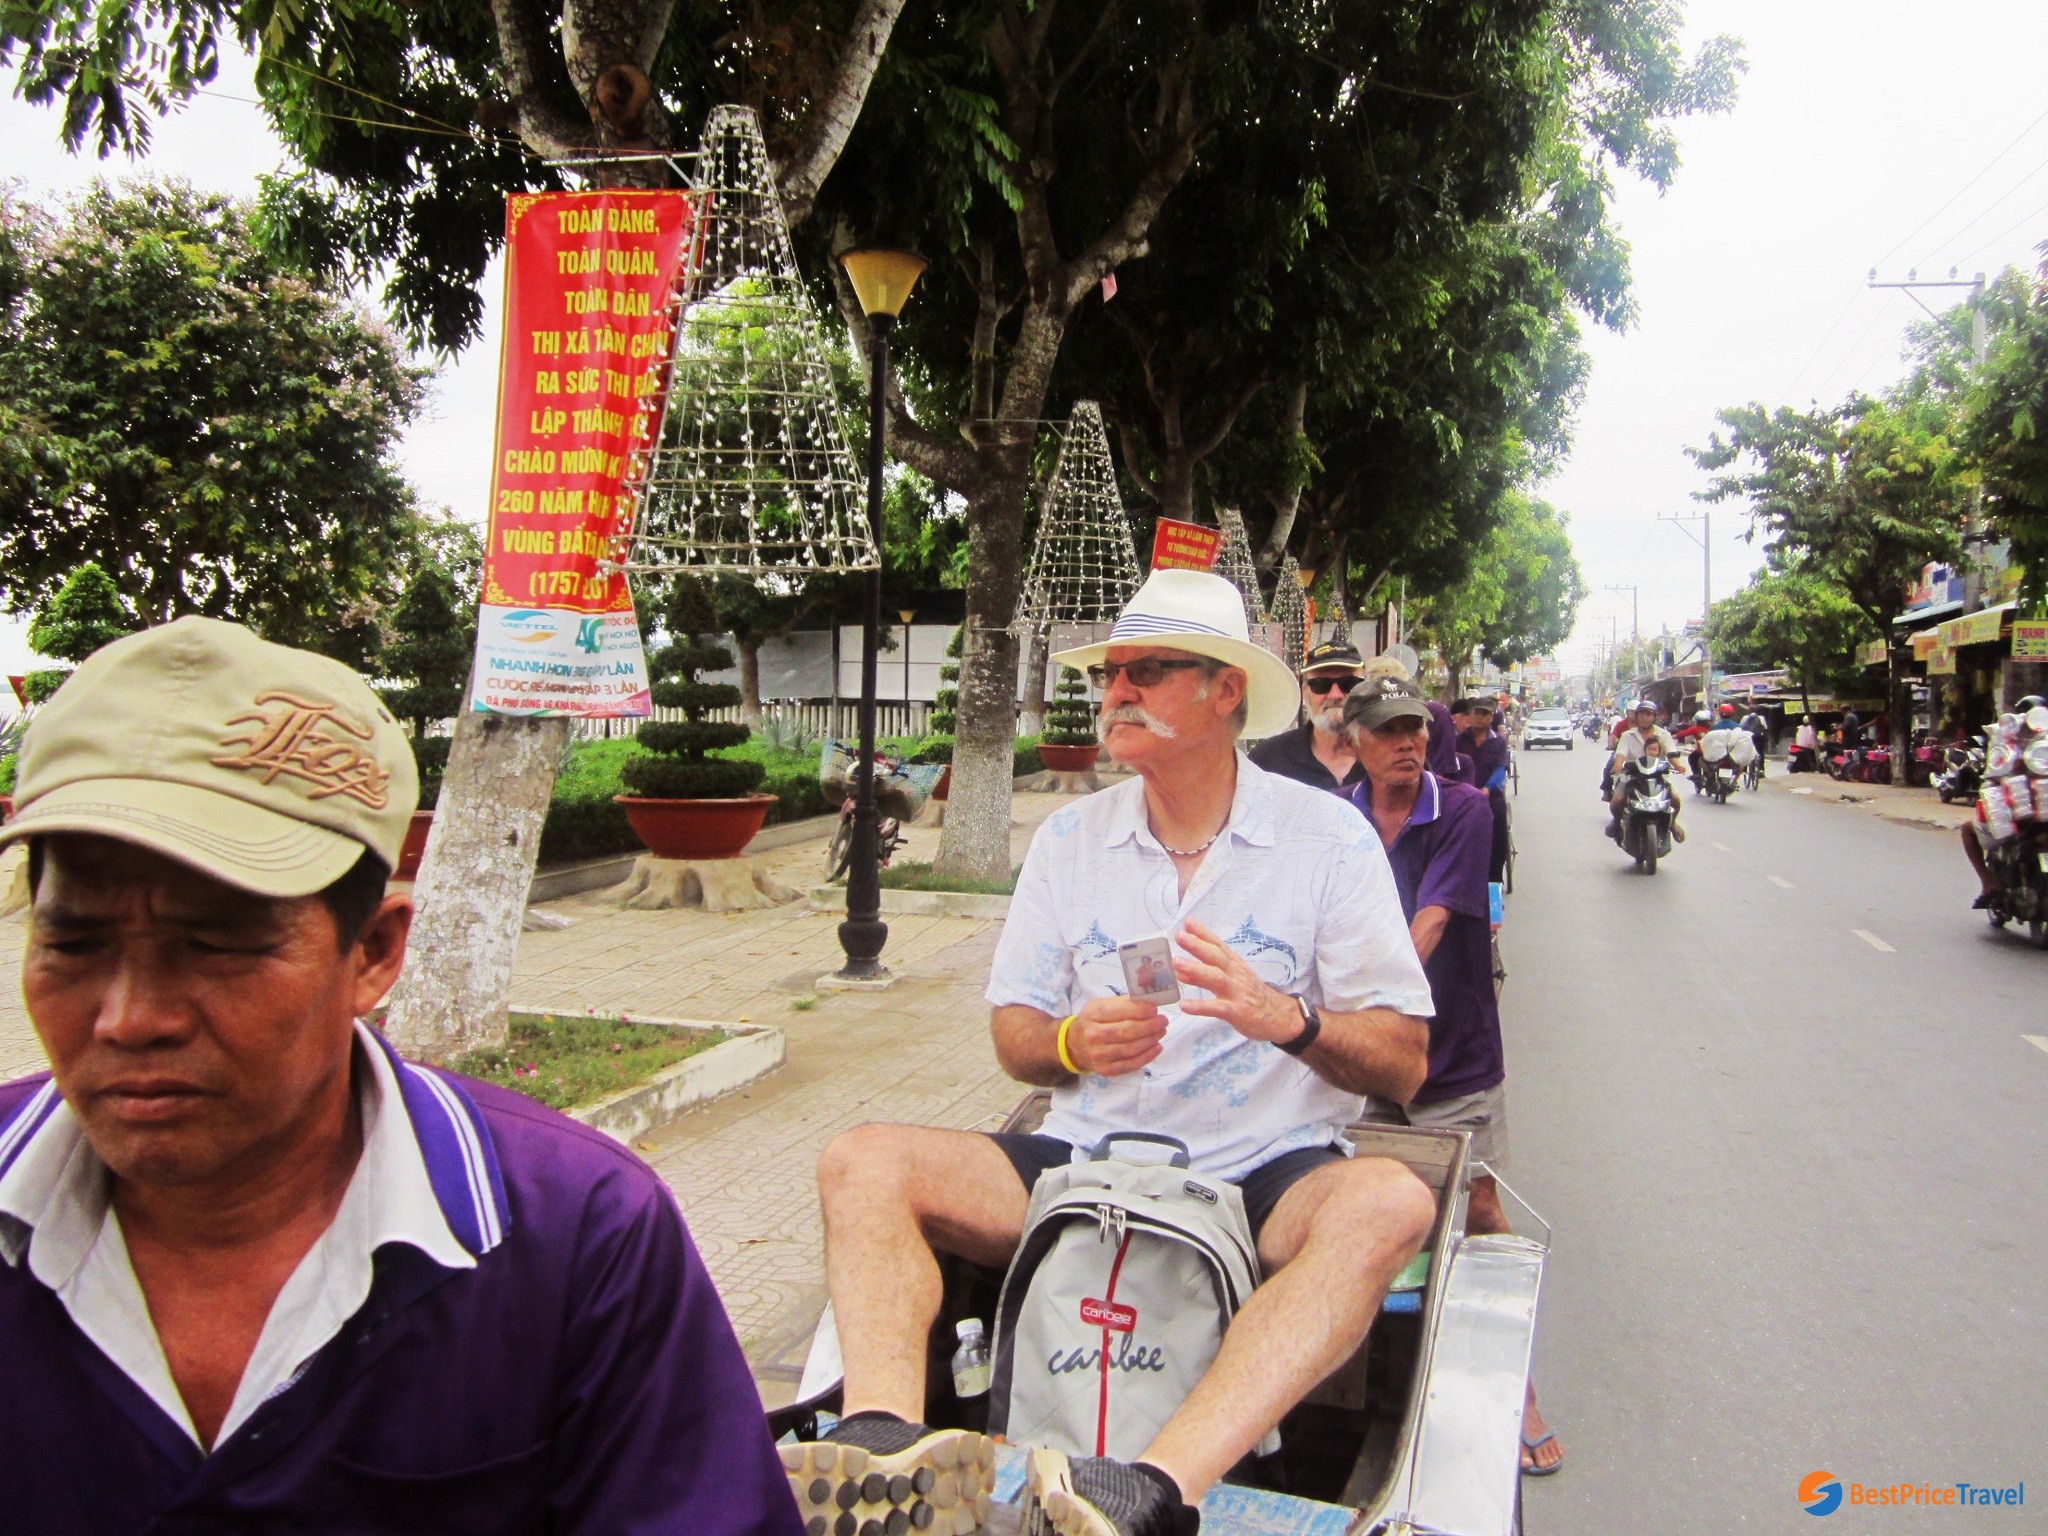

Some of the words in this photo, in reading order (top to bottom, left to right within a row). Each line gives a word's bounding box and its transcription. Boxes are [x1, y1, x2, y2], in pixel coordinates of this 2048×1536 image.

[558, 205, 602, 234] TOÀN
[608, 201, 659, 236] ĐẢNG,
[557, 247, 600, 275] TOÀN
[606, 247, 659, 276] QUÂN,
[565, 286, 608, 315] TOÀN
[613, 288, 649, 317] DÂN
[532, 331, 560, 360] THỊ
[565, 326, 590, 354] XÃ
[594, 324, 625, 356] TÂN
[536, 371, 560, 394] RA
[565, 366, 600, 394] SỨC
[606, 369, 629, 398] THI
[530, 406, 567, 439] LẬP
[573, 404, 624, 438] THÀNH
[504, 445, 556, 474] CHÀO
[498, 490, 535, 513] 260
[539, 486, 583, 515] NĂM
[502, 525, 555, 555] VÙNG
[489, 657, 545, 674] NHANH
[1082, 1305, 1132, 1325] caribee
